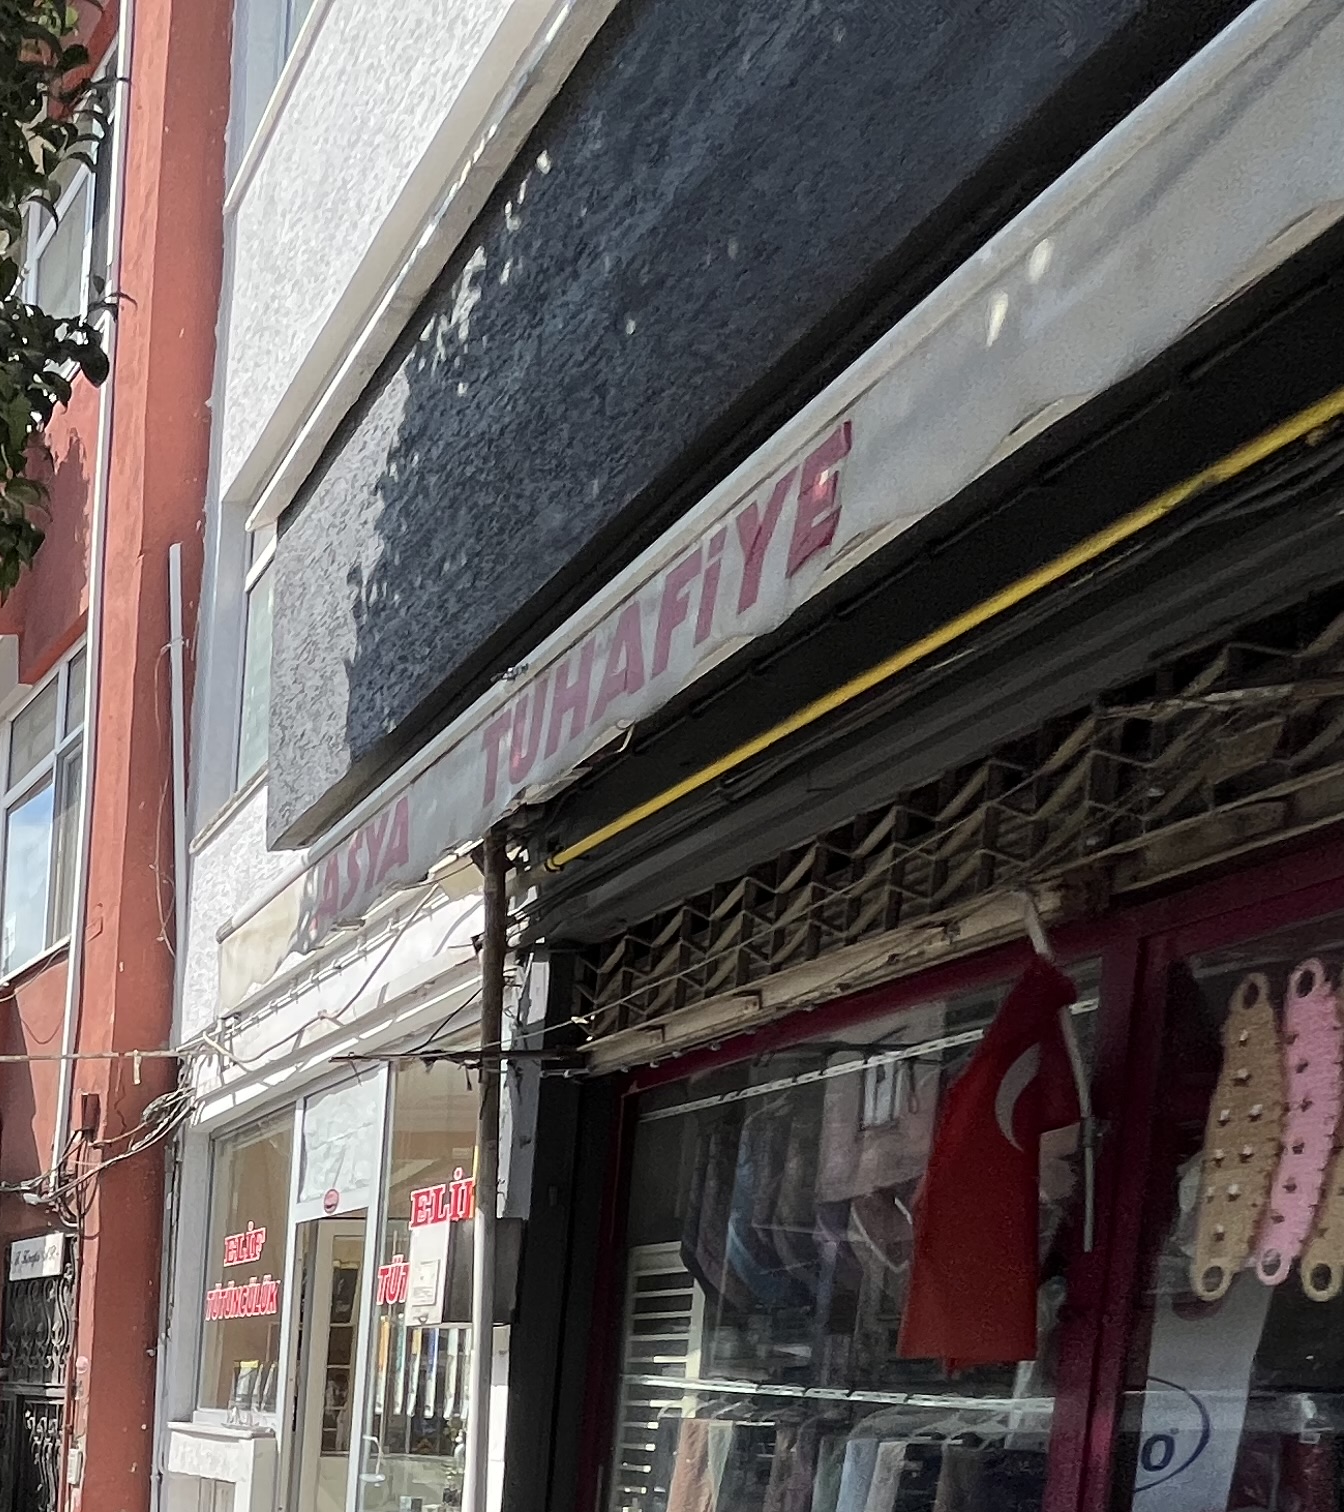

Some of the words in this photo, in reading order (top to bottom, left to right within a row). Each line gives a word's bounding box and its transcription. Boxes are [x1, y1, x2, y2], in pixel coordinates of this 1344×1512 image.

[313, 797, 410, 933] ASYA
[480, 419, 854, 804] TUHAFİYE
[223, 1220, 267, 1268] ELİF
[205, 1273, 282, 1322] TÜTÜNCÜLÜK
